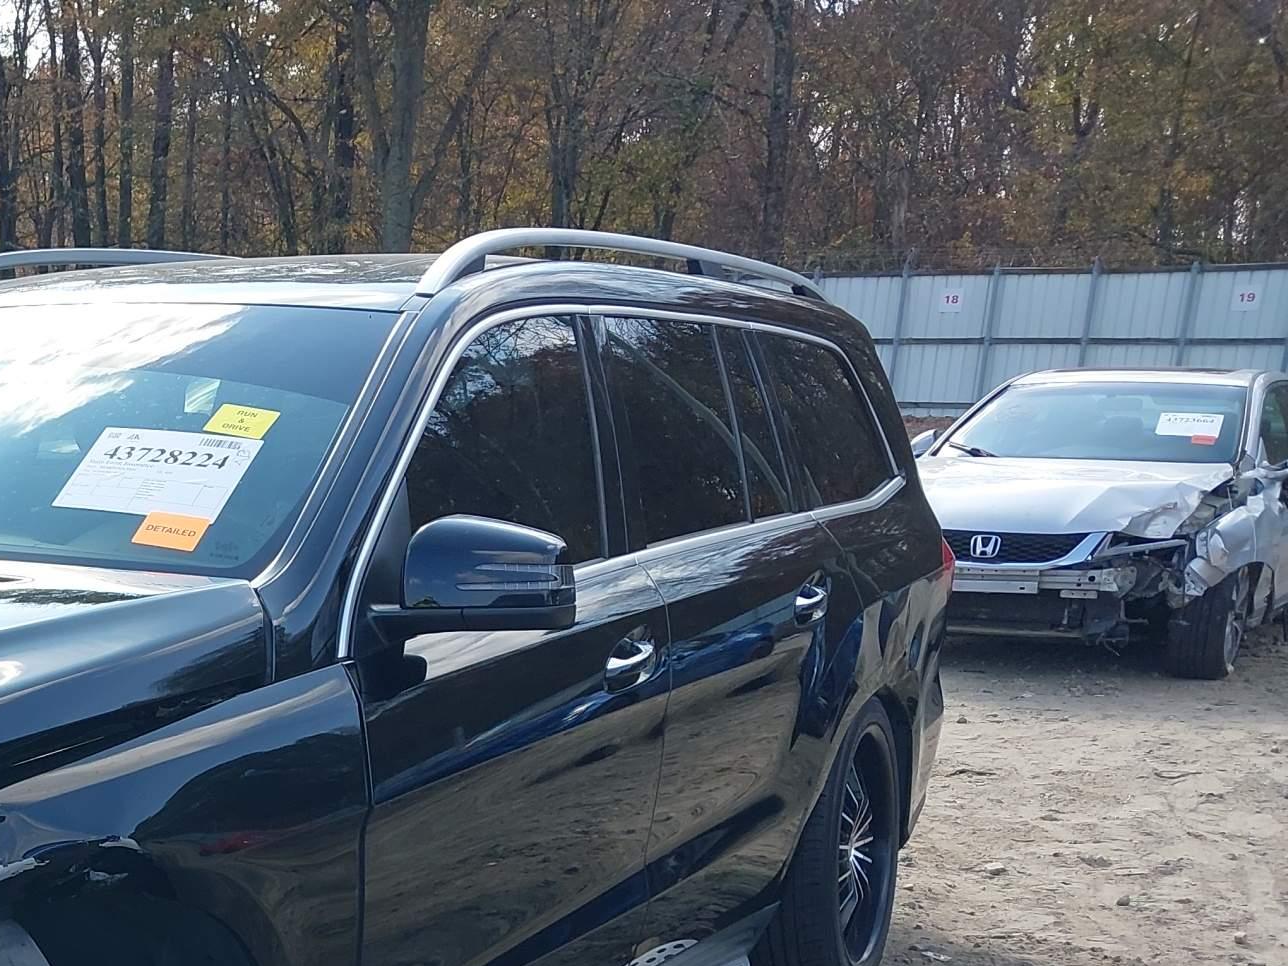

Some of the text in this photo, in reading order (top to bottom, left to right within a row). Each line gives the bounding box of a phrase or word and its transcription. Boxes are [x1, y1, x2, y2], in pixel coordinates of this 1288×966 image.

[944, 294, 960, 306] 18
[1239, 292, 1256, 303] 19
[236, 410, 259, 418] RUN
[221, 423, 252, 433] DRIVE
[103, 445, 230, 470] 43728224
[145, 524, 197, 537] DETAILED
